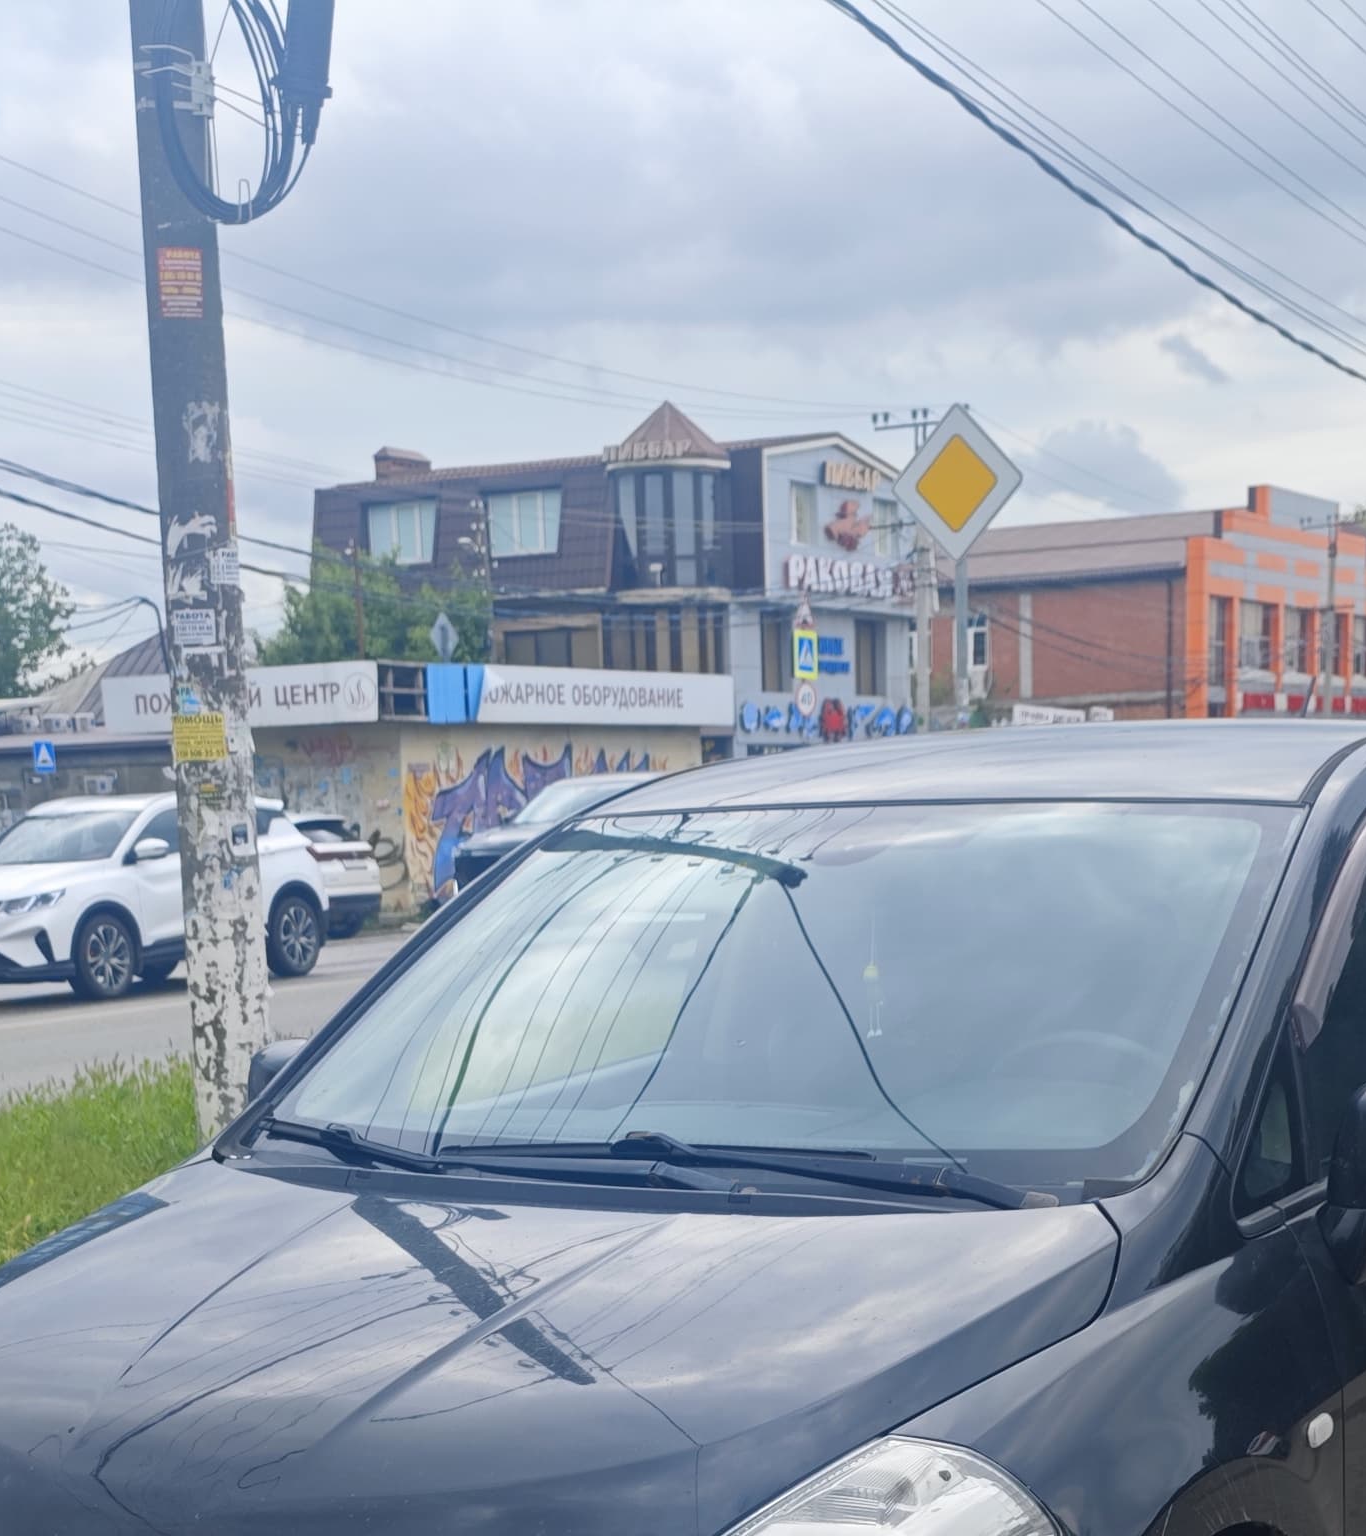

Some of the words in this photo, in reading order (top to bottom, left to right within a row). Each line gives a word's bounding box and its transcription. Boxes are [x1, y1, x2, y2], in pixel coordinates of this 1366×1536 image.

[274, 682, 341, 712] ЦЕНТР
[483, 683, 566, 706] ОЖАРНОЕ
[571, 683, 684, 711] ОБОРУДОВАНИЕ
